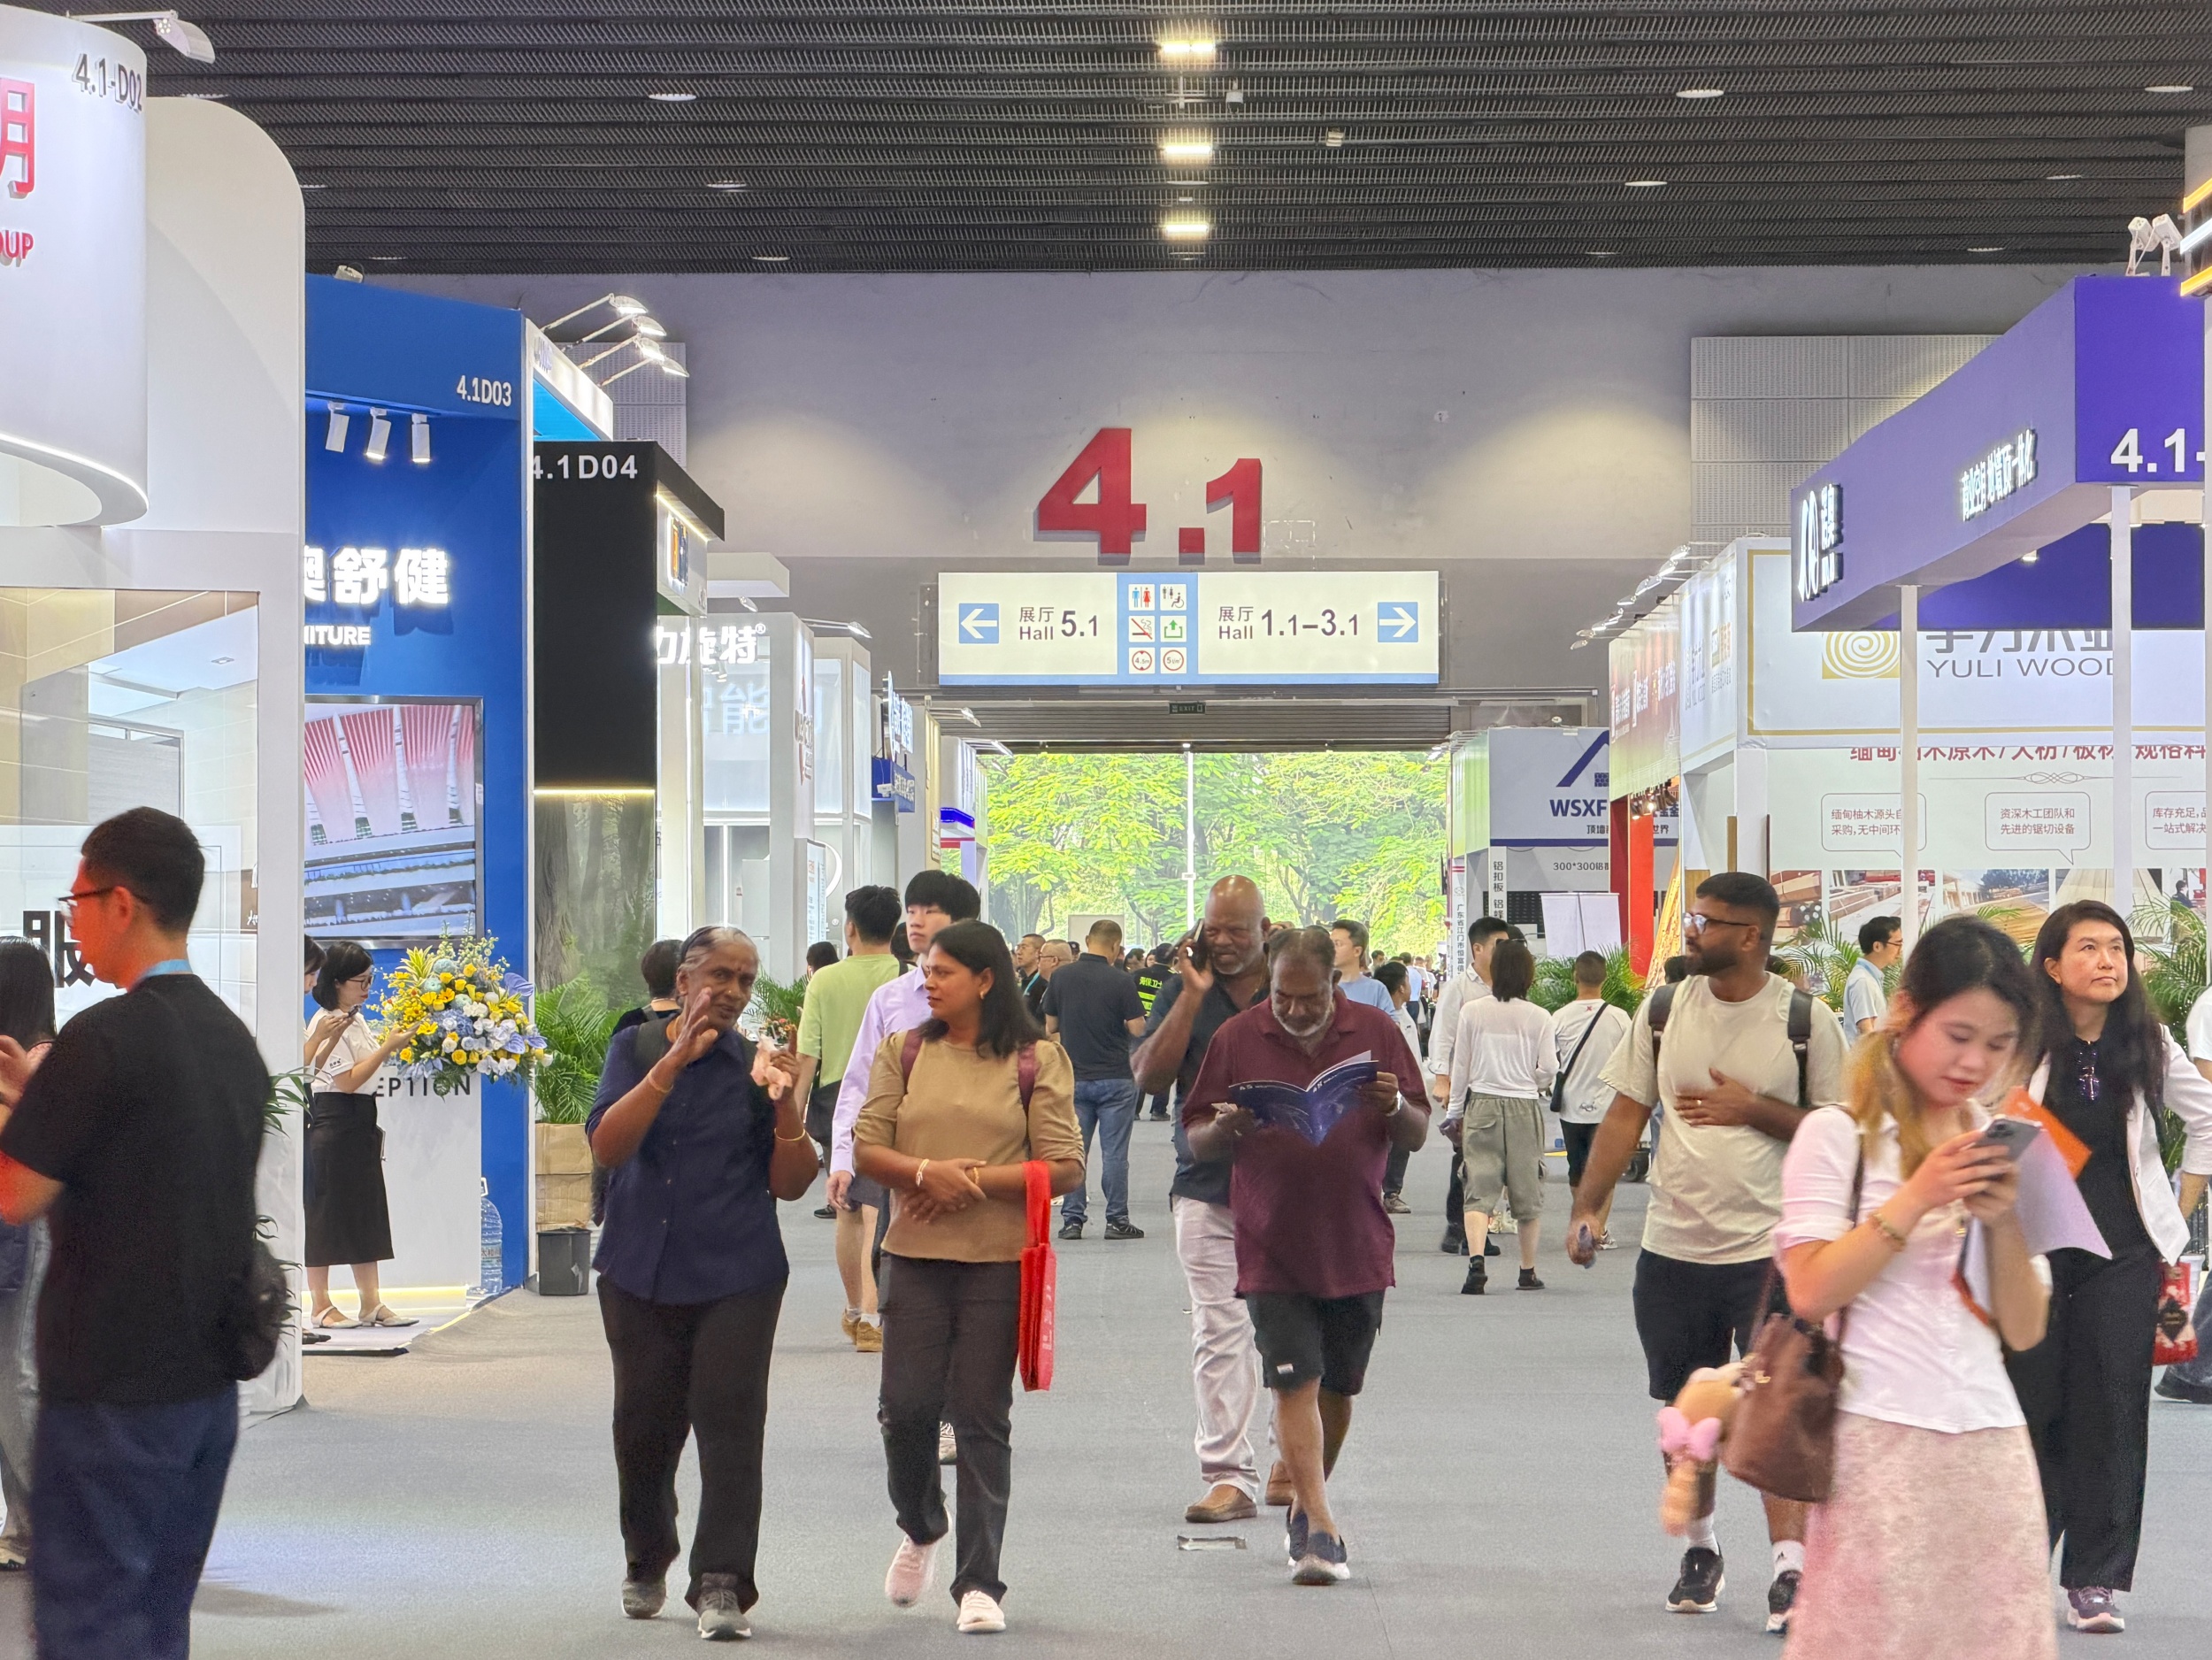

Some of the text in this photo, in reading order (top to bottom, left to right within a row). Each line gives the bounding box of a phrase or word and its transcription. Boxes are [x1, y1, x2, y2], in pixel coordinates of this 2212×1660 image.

[73, 53, 142, 113] 4.1-D02
[456, 375, 512, 407] 4.1D03
[533, 454, 638, 480] 4.1D04
[1038, 427, 1262, 555] 4.1
[1019, 606, 1055, 623] 展厅
[1019, 610, 1098, 641] Hall 5.1
[1218, 606, 1255, 622] 展厅
[1218, 625, 1254, 640] Hall
[1926, 658, 2002, 679] YULI
[2000, 807, 2075, 819] 资深木工团队和
[2000, 823, 2075, 835] 先进的锯切设备
[1456, 903, 1465, 974] 广东省江门市恒富信
